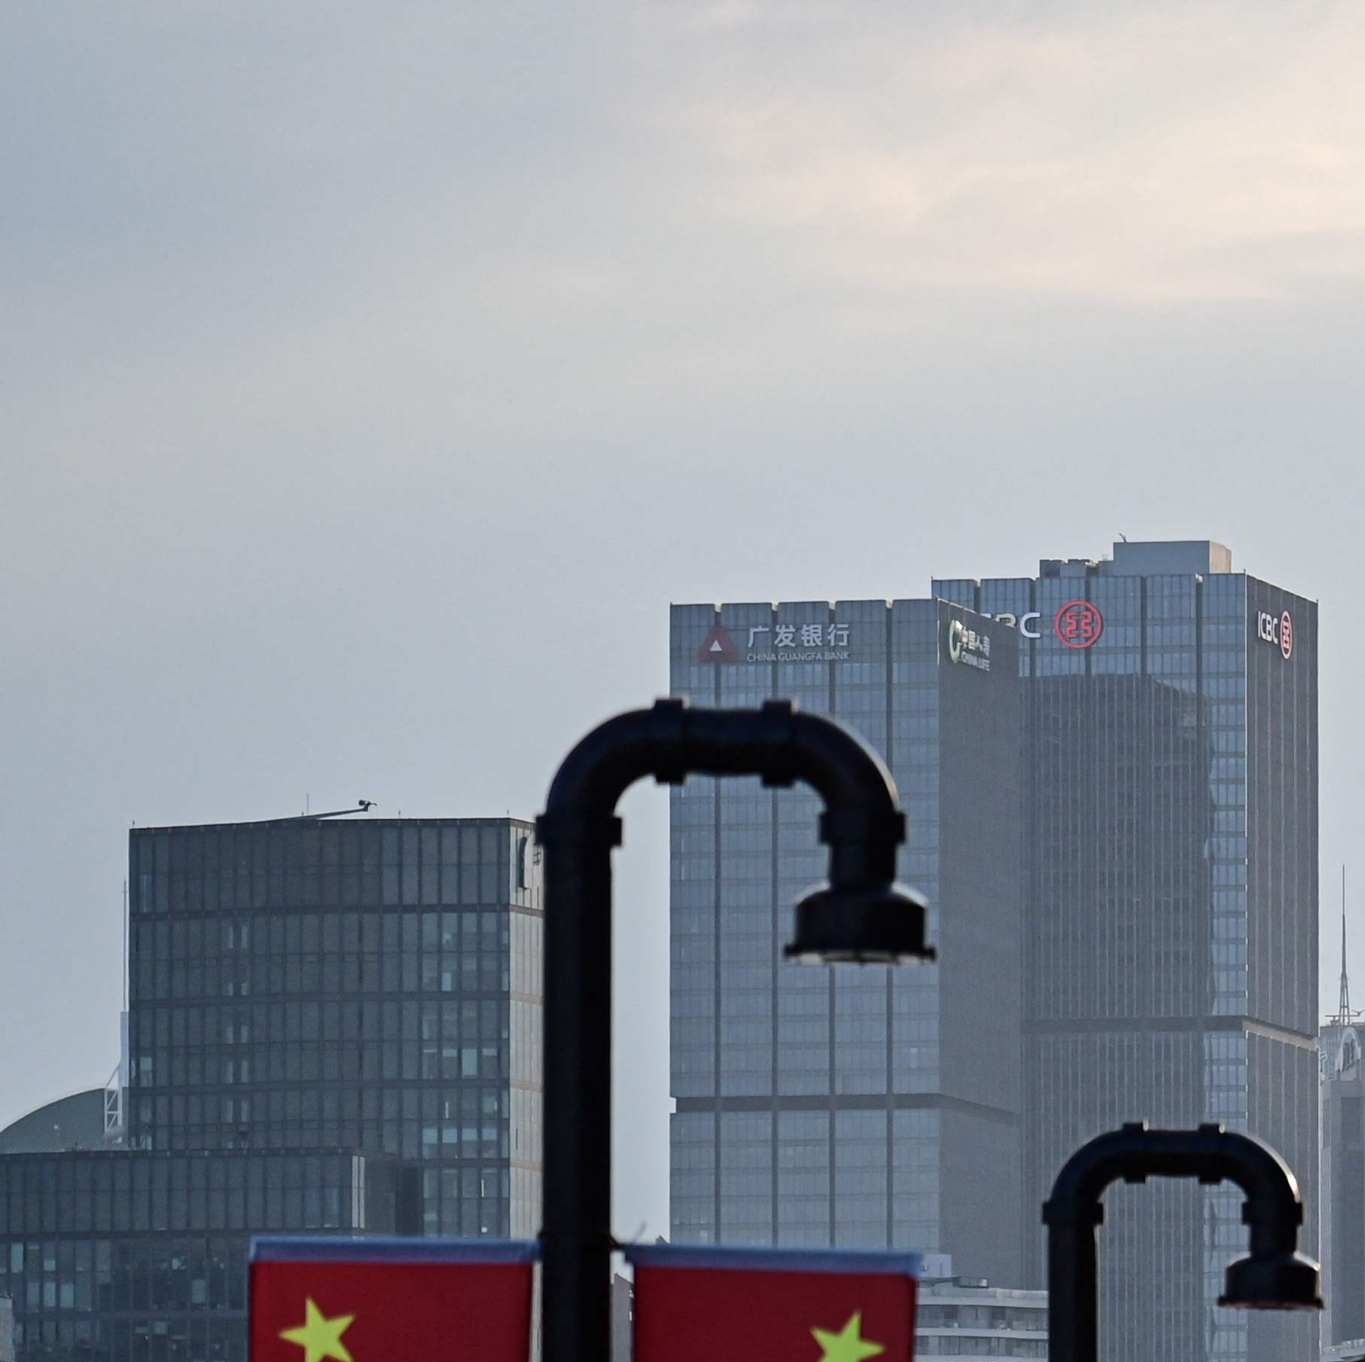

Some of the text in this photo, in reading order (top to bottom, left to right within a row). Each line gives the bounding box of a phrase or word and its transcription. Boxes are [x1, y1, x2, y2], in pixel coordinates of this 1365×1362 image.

[748, 624, 849, 648] 广发银行
[1257, 611, 1278, 644] ICBC
[747, 651, 849, 663] CHINA GUANGFA BANK
